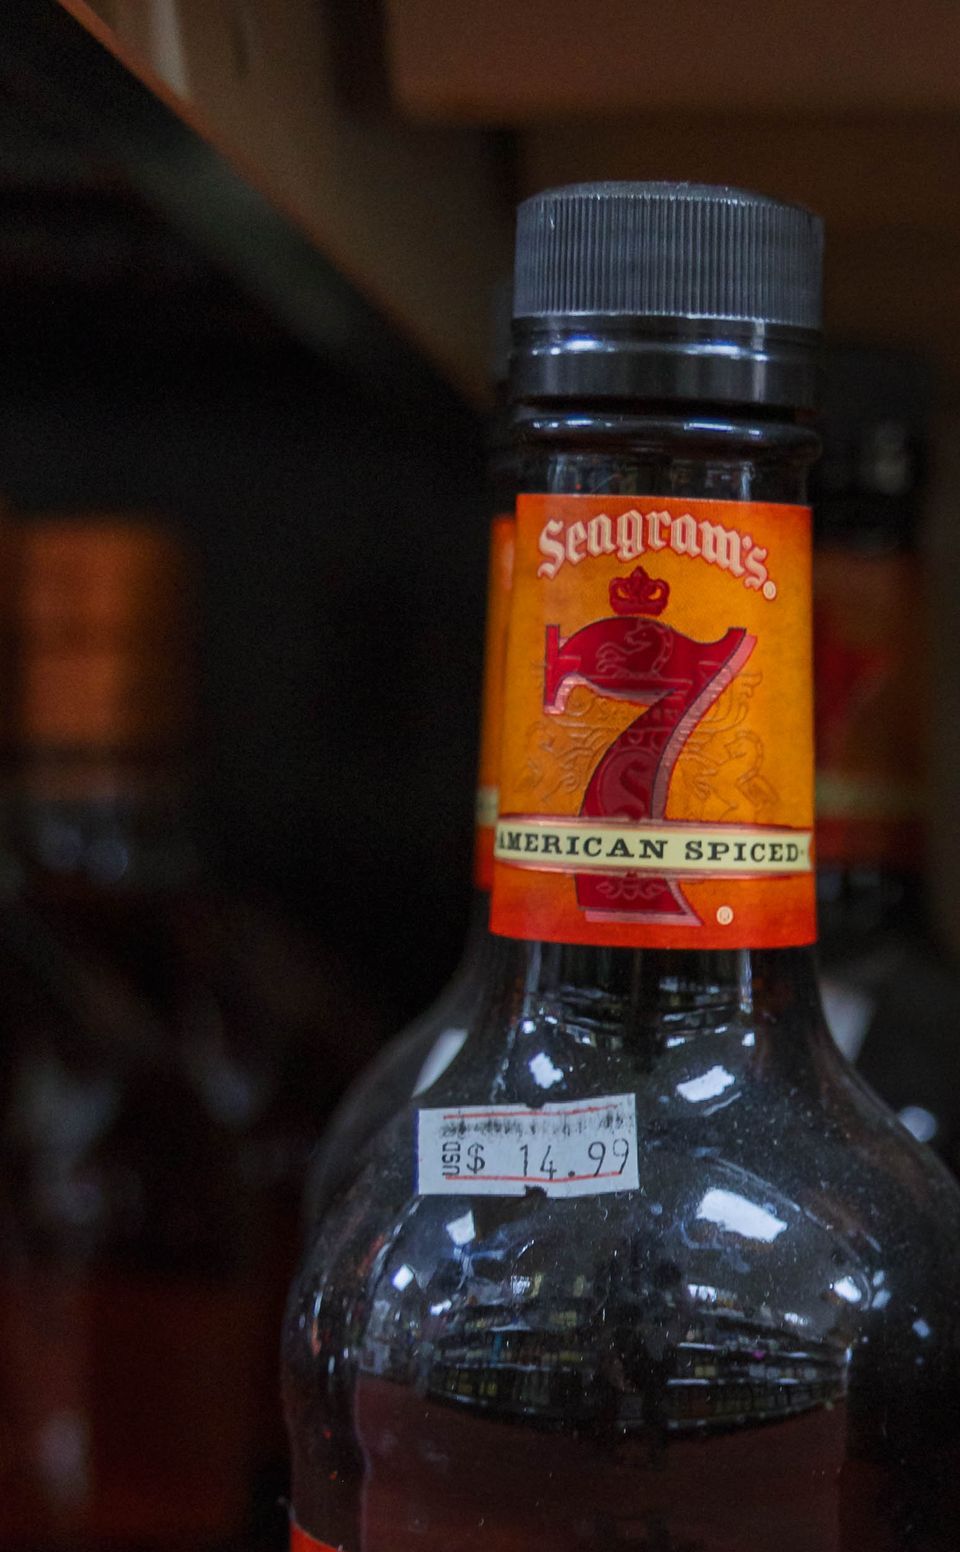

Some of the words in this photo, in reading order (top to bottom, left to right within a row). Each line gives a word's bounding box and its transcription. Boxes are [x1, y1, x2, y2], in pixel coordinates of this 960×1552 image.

[543, 615, 756, 927] 7
[685, 842, 799, 863] SPICED
[518, 1137, 630, 1182] 14.99
